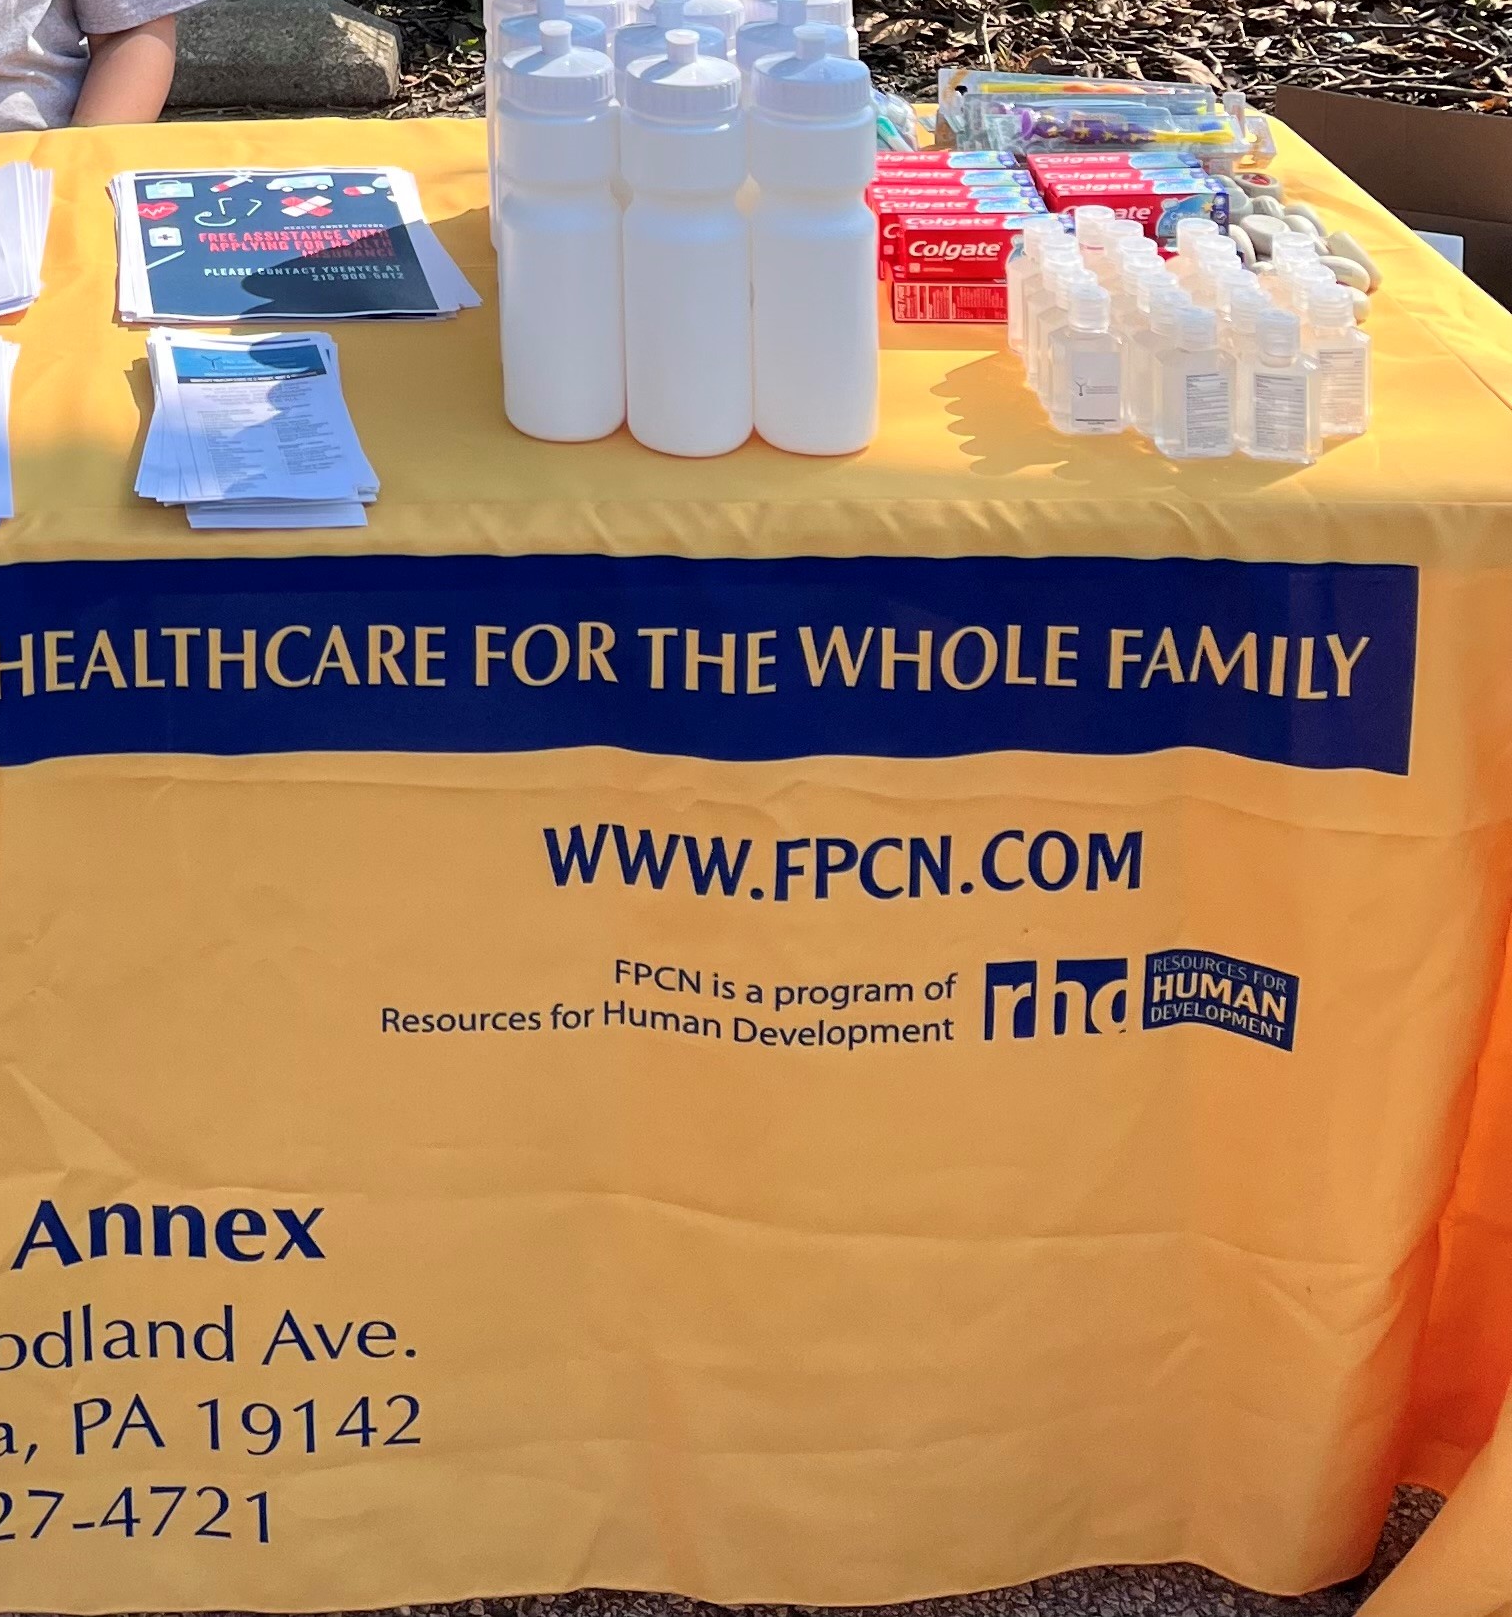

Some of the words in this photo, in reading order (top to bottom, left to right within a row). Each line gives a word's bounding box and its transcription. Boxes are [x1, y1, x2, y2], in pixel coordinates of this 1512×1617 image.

[1035, 155, 1121, 165] Colgate
[1044, 171, 1133, 181] Colgate
[1056, 183, 1145, 193] Colgate
[872, 186, 962, 197] Colgate
[879, 200, 970, 211] Colgate
[198, 232, 237, 243] FREE
[243, 229, 343, 242] ASSISTANCE
[905, 217, 998, 228] Colgate
[209, 240, 290, 253] APPLYING
[294, 240, 325, 251] FOR
[908, 240, 1002, 261] Colgate
[204, 267, 253, 277] PLEASE
[257, 266, 316, 276] CONTACT
[385, 264, 401, 272] AT
[474, 621, 618, 687] FOR
[637, 627, 777, 695] THE
[798, 624, 1080, 692] WHOLE
[1108, 625, 1371, 700] FAMILY
[542, 823, 1144, 902] WWW.FPCN.COM
[614, 959, 701, 994] FPCN
[712, 972, 736, 1000] is
[745, 984, 763, 1004] a
[775, 983, 914, 1011] program
[924, 972, 959, 1001] of
[1153, 955, 1247, 982] RESOURCES
[1253, 972, 1287, 993] FOR
[1151, 973, 1287, 1023] HUMAN
[381, 1007, 542, 1033] Resources
[550, 1003, 595, 1030] for
[603, 1000, 722, 1039] Human
[733, 1017, 955, 1051] Development
[1151, 1002, 1285, 1043] DEVELOPMENT
[10, 1198, 326, 1272] Annex
[261, 1309, 419, 1366] Ave.
[73, 1393, 166, 1456] PA
[197, 1393, 422, 1456] 19142
